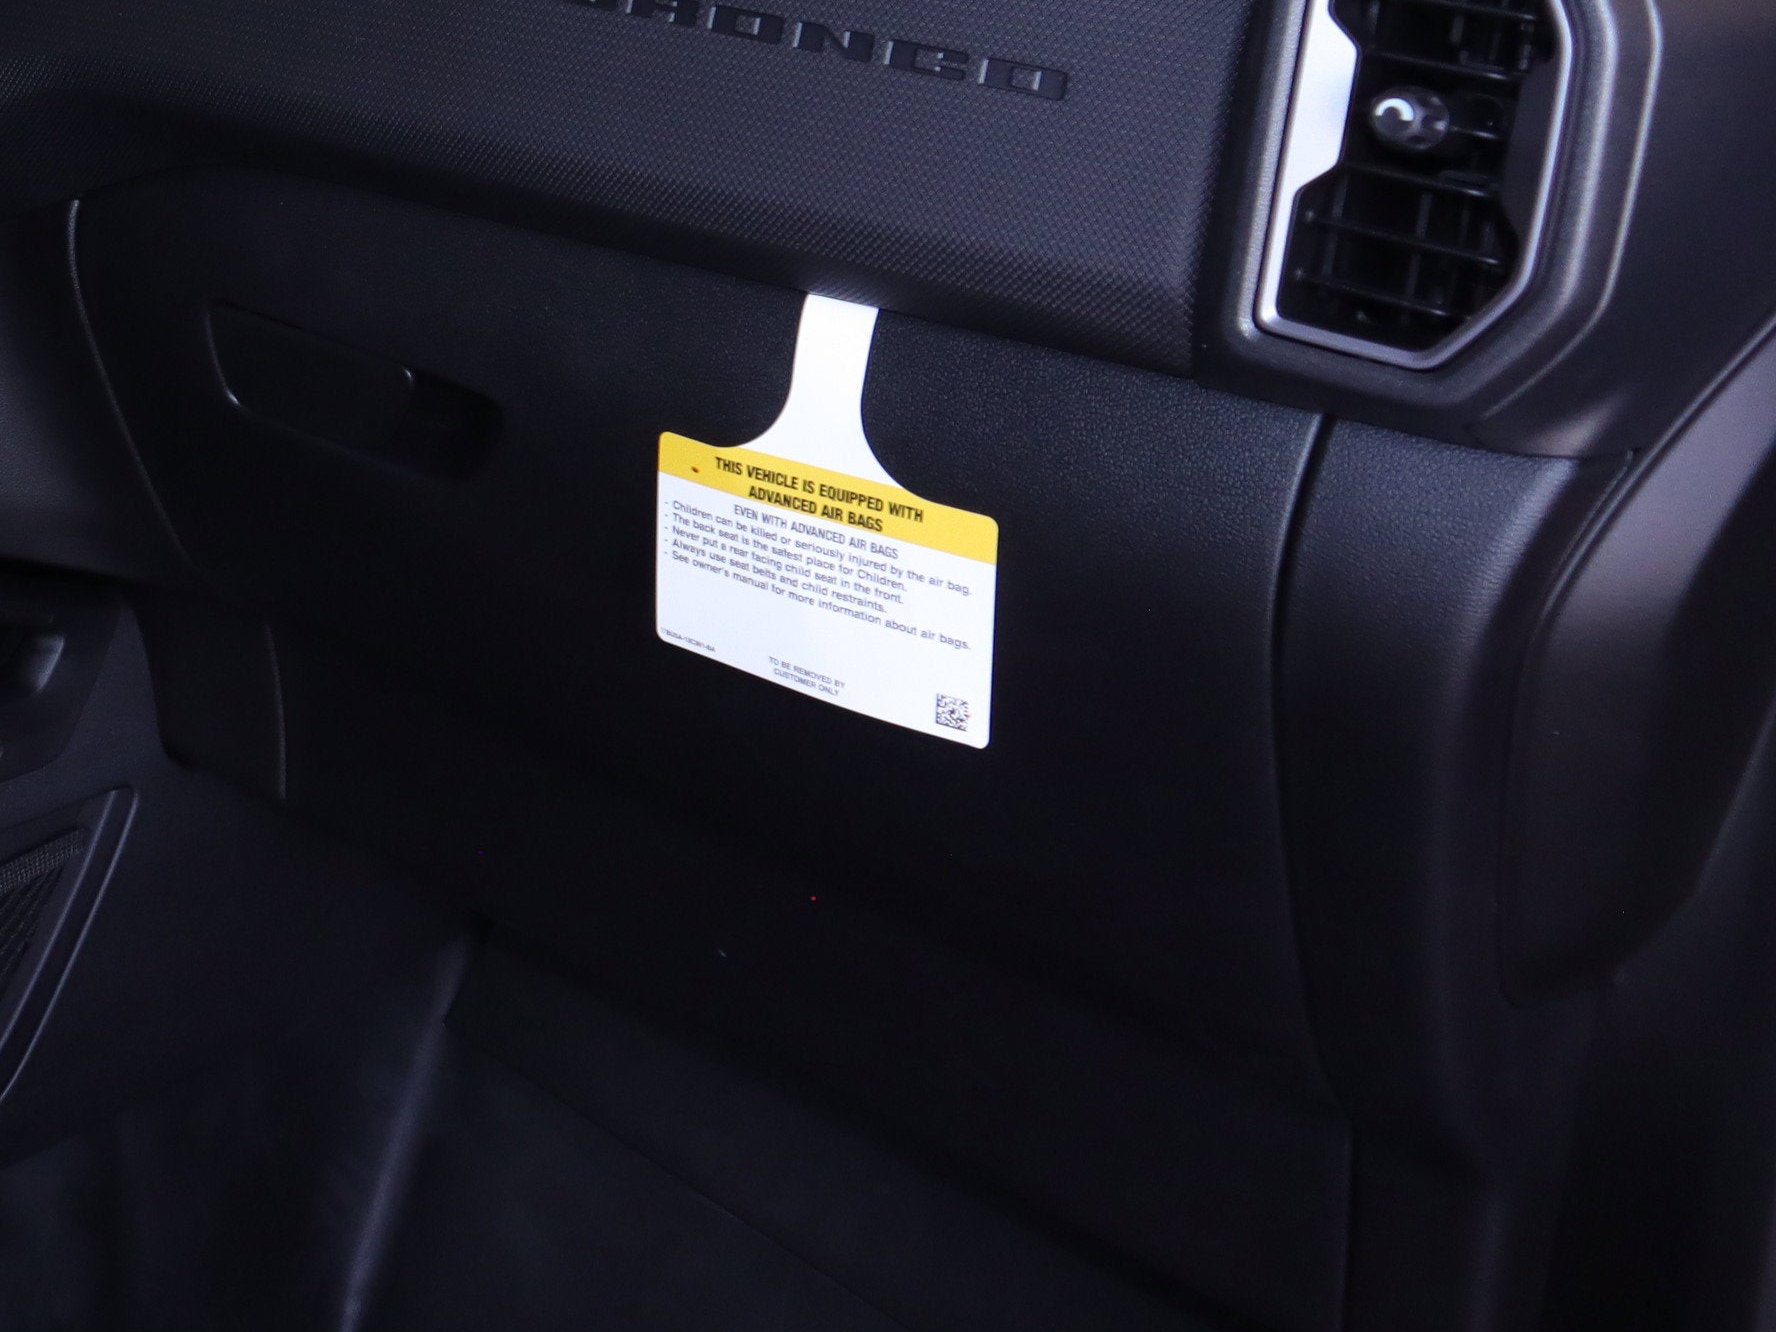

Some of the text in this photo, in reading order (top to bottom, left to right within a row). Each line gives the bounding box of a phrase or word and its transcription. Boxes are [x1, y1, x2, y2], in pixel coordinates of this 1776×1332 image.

[715, 456, 924, 523] THIS VEHICLE IS EQUIPPED WITH
[748, 485, 884, 532] ADVANCED AIR BAGS
[672, 500, 973, 596] Children can be killed or seriously injured by the air bag.
[672, 512, 907, 592] The back seat is the safest place for Children.
[672, 525, 904, 604] Never put a rear facing child seat in the front.
[734, 504, 899, 559] EVEN WITH ADVANCED AIR BAGS
[672, 538, 887, 614] Always use seat belts and child restraints.
[672, 550, 972, 651] See owner's manual for more information about air bags.
[768, 656, 846, 689] TO BE REMOVED BY
[774, 668, 840, 697] CUSTOMER ONLY
